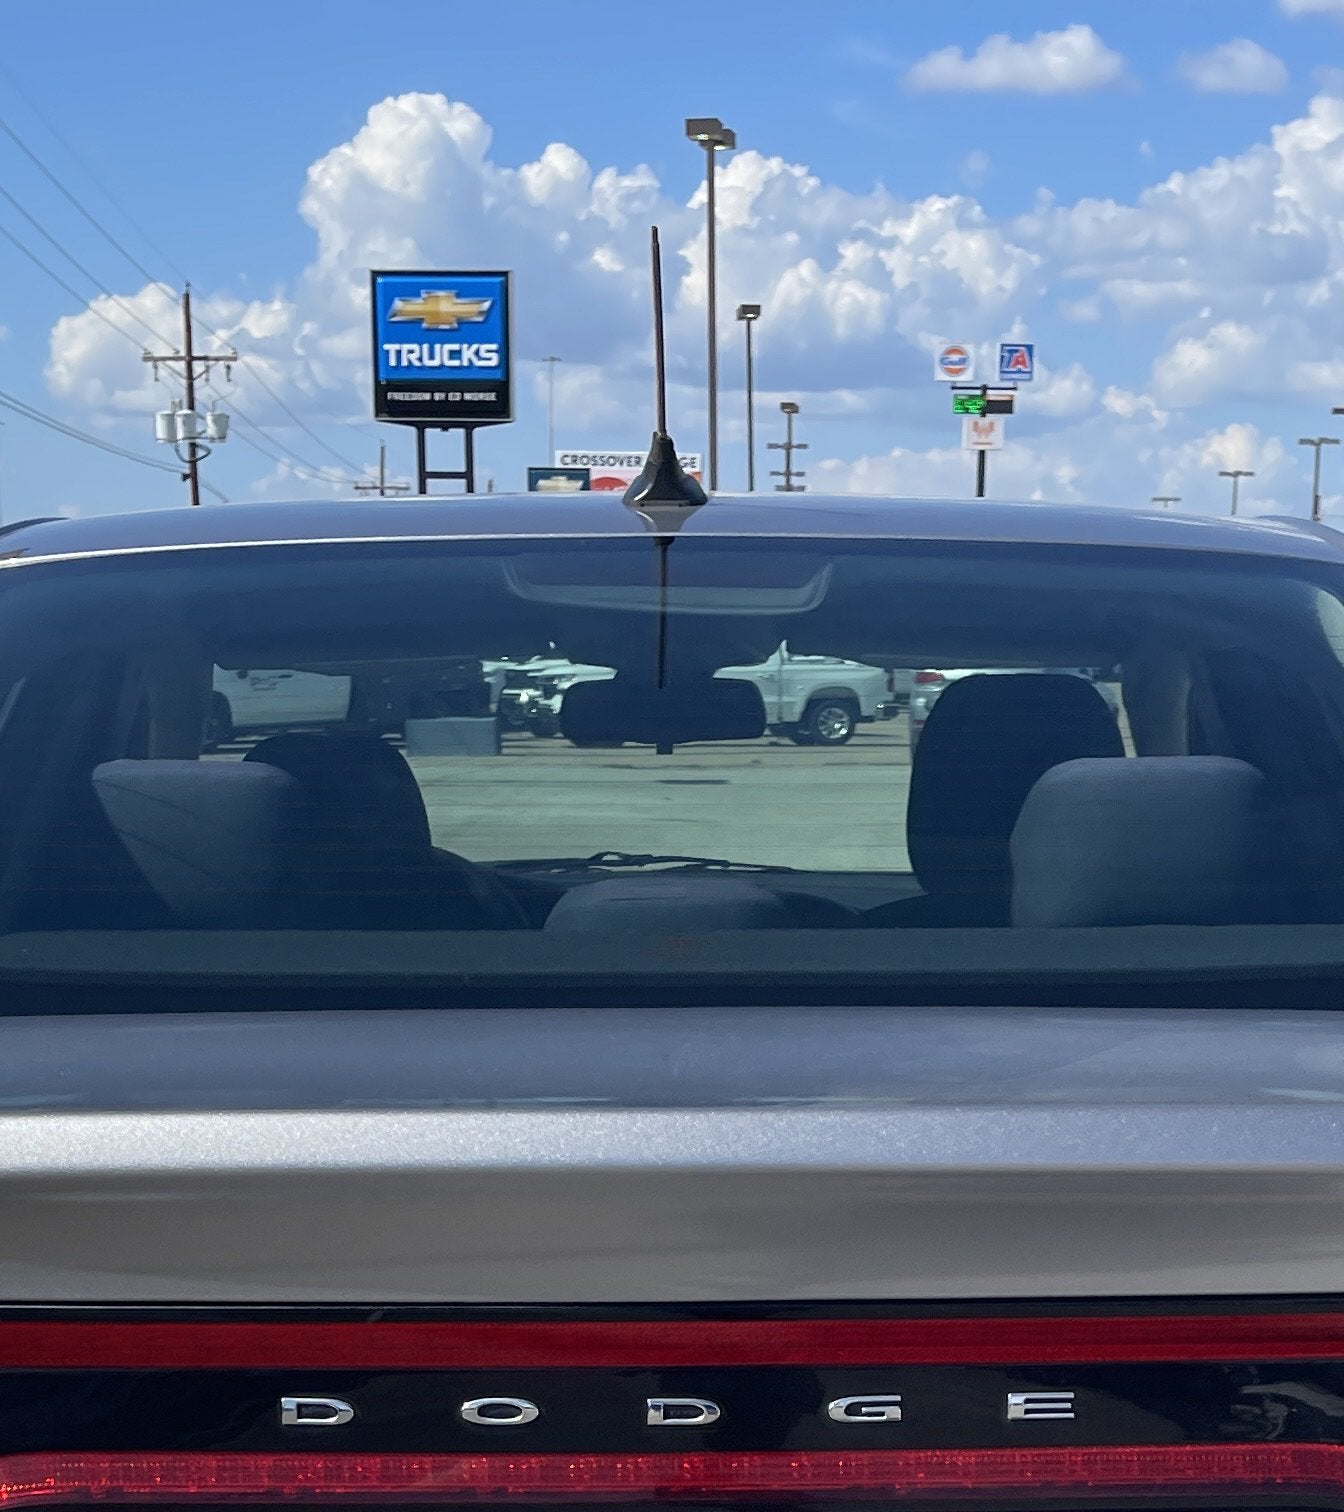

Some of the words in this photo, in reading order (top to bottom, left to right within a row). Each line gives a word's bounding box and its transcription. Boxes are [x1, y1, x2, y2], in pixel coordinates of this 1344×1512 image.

[382, 343, 499, 367] TRUCKS
[559, 454, 643, 467] CROSSOVER
[281, 1391, 1076, 1426] DODGE
